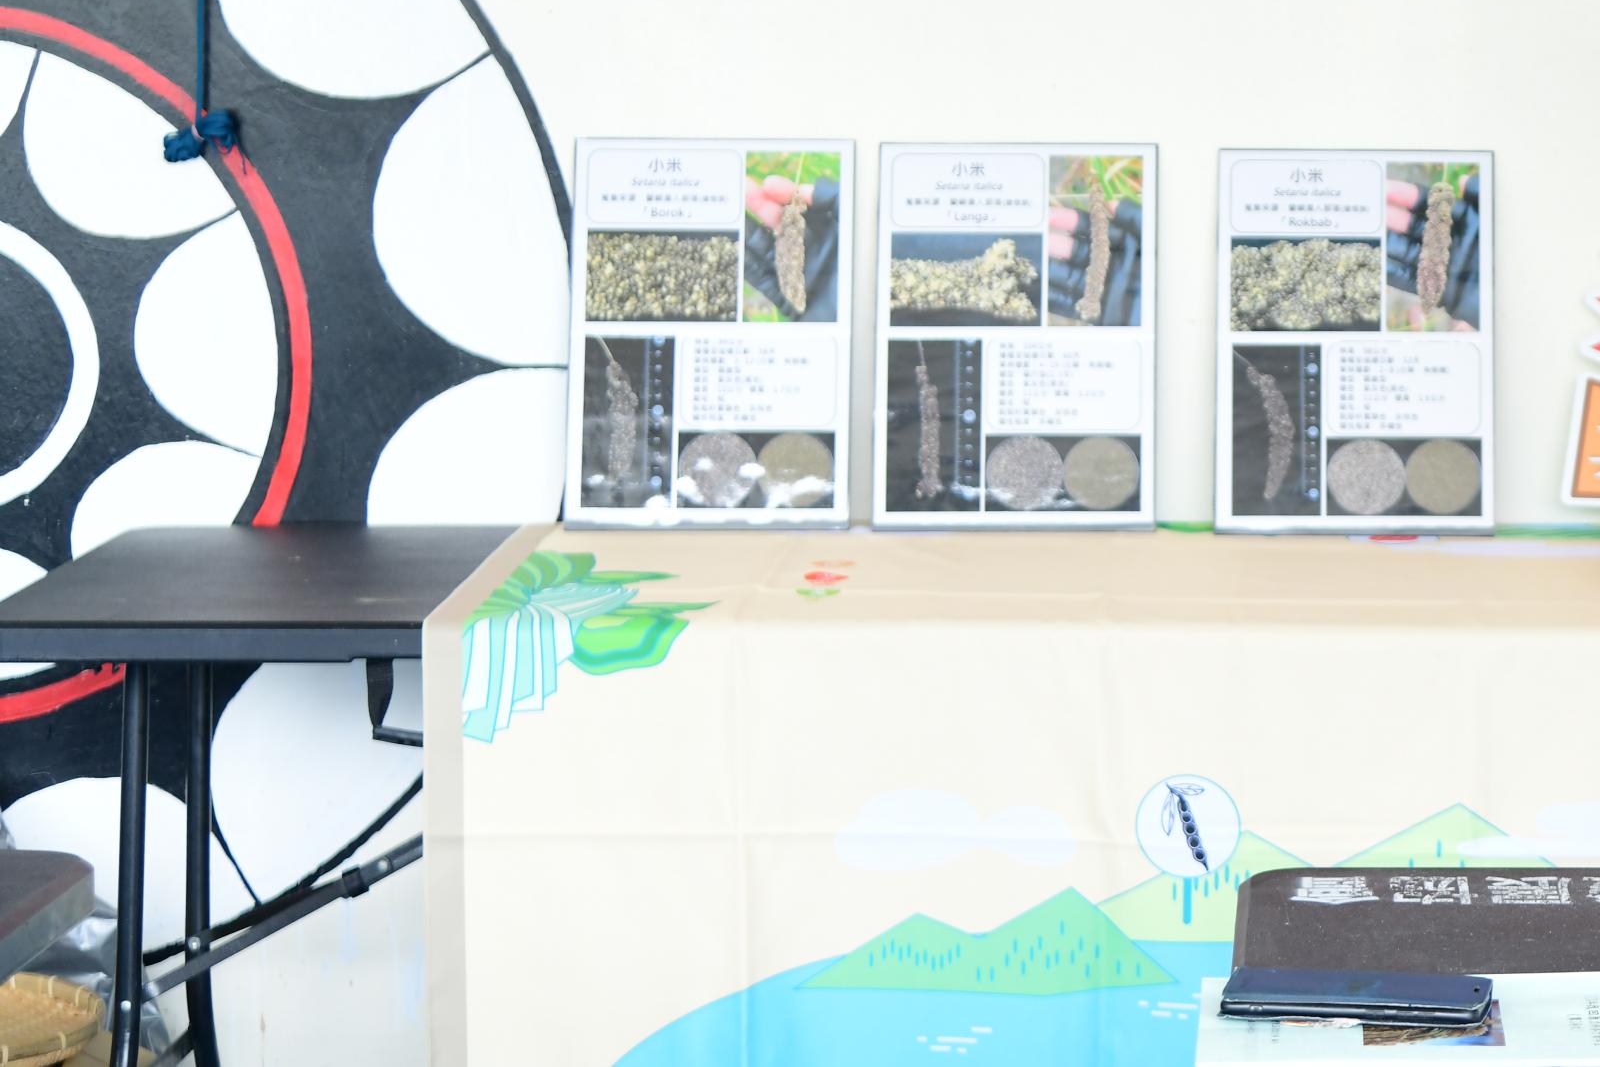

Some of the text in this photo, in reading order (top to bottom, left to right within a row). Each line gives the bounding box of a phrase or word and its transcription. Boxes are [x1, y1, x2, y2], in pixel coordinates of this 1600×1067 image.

[647, 157, 683, 174] 小米
[951, 160, 985, 177] 小米
[1289, 166, 1324, 183] 小米
